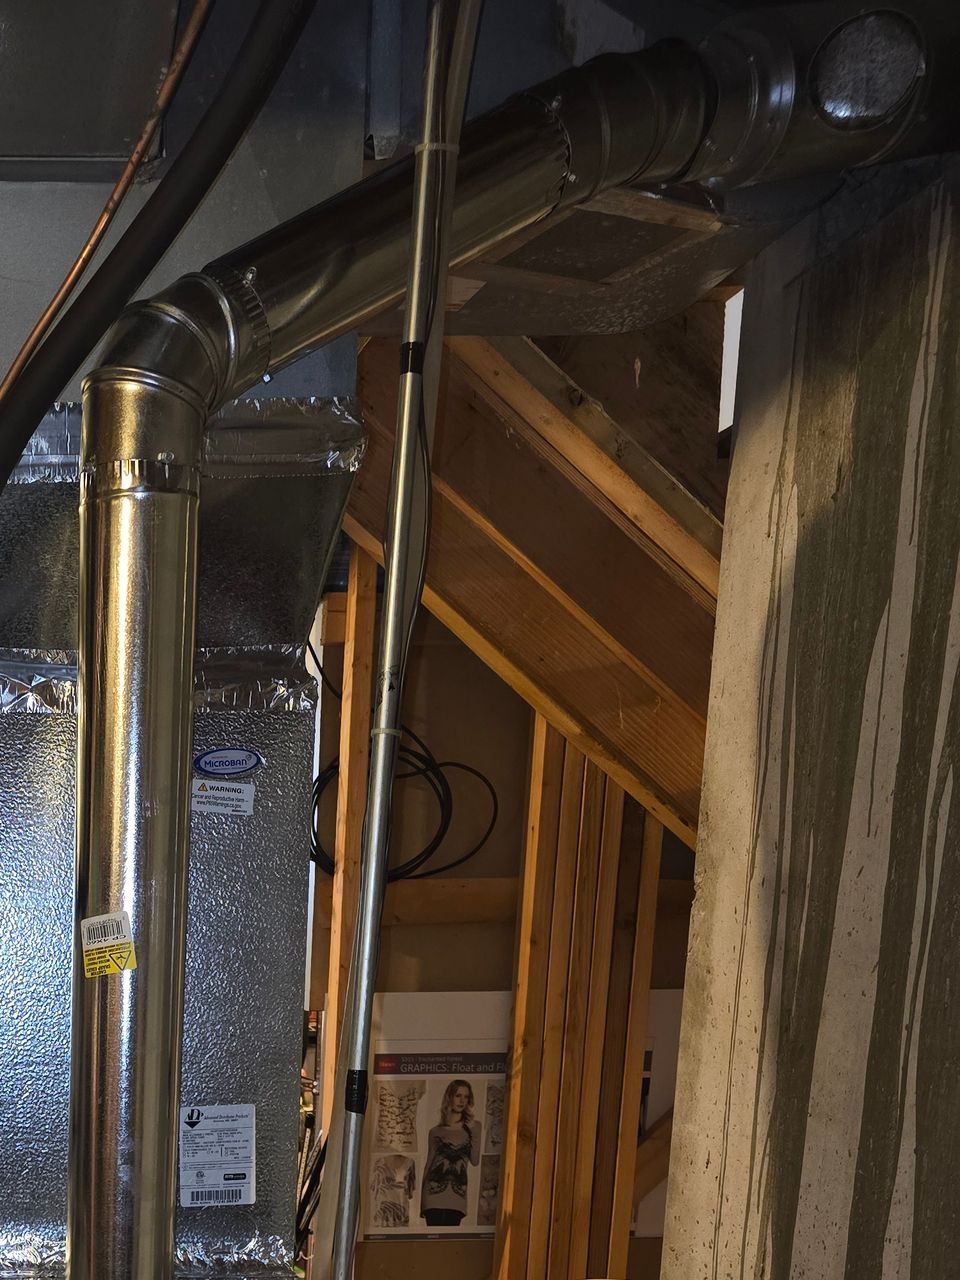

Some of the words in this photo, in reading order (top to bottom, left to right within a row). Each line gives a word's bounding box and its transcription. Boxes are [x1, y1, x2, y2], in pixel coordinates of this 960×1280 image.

[209, 785, 244, 794] WARNING:
[400, 1063, 449, 1073] GRAPHICS:
[452, 1062, 474, 1072] Float
[476, 1062, 494, 1072] and
